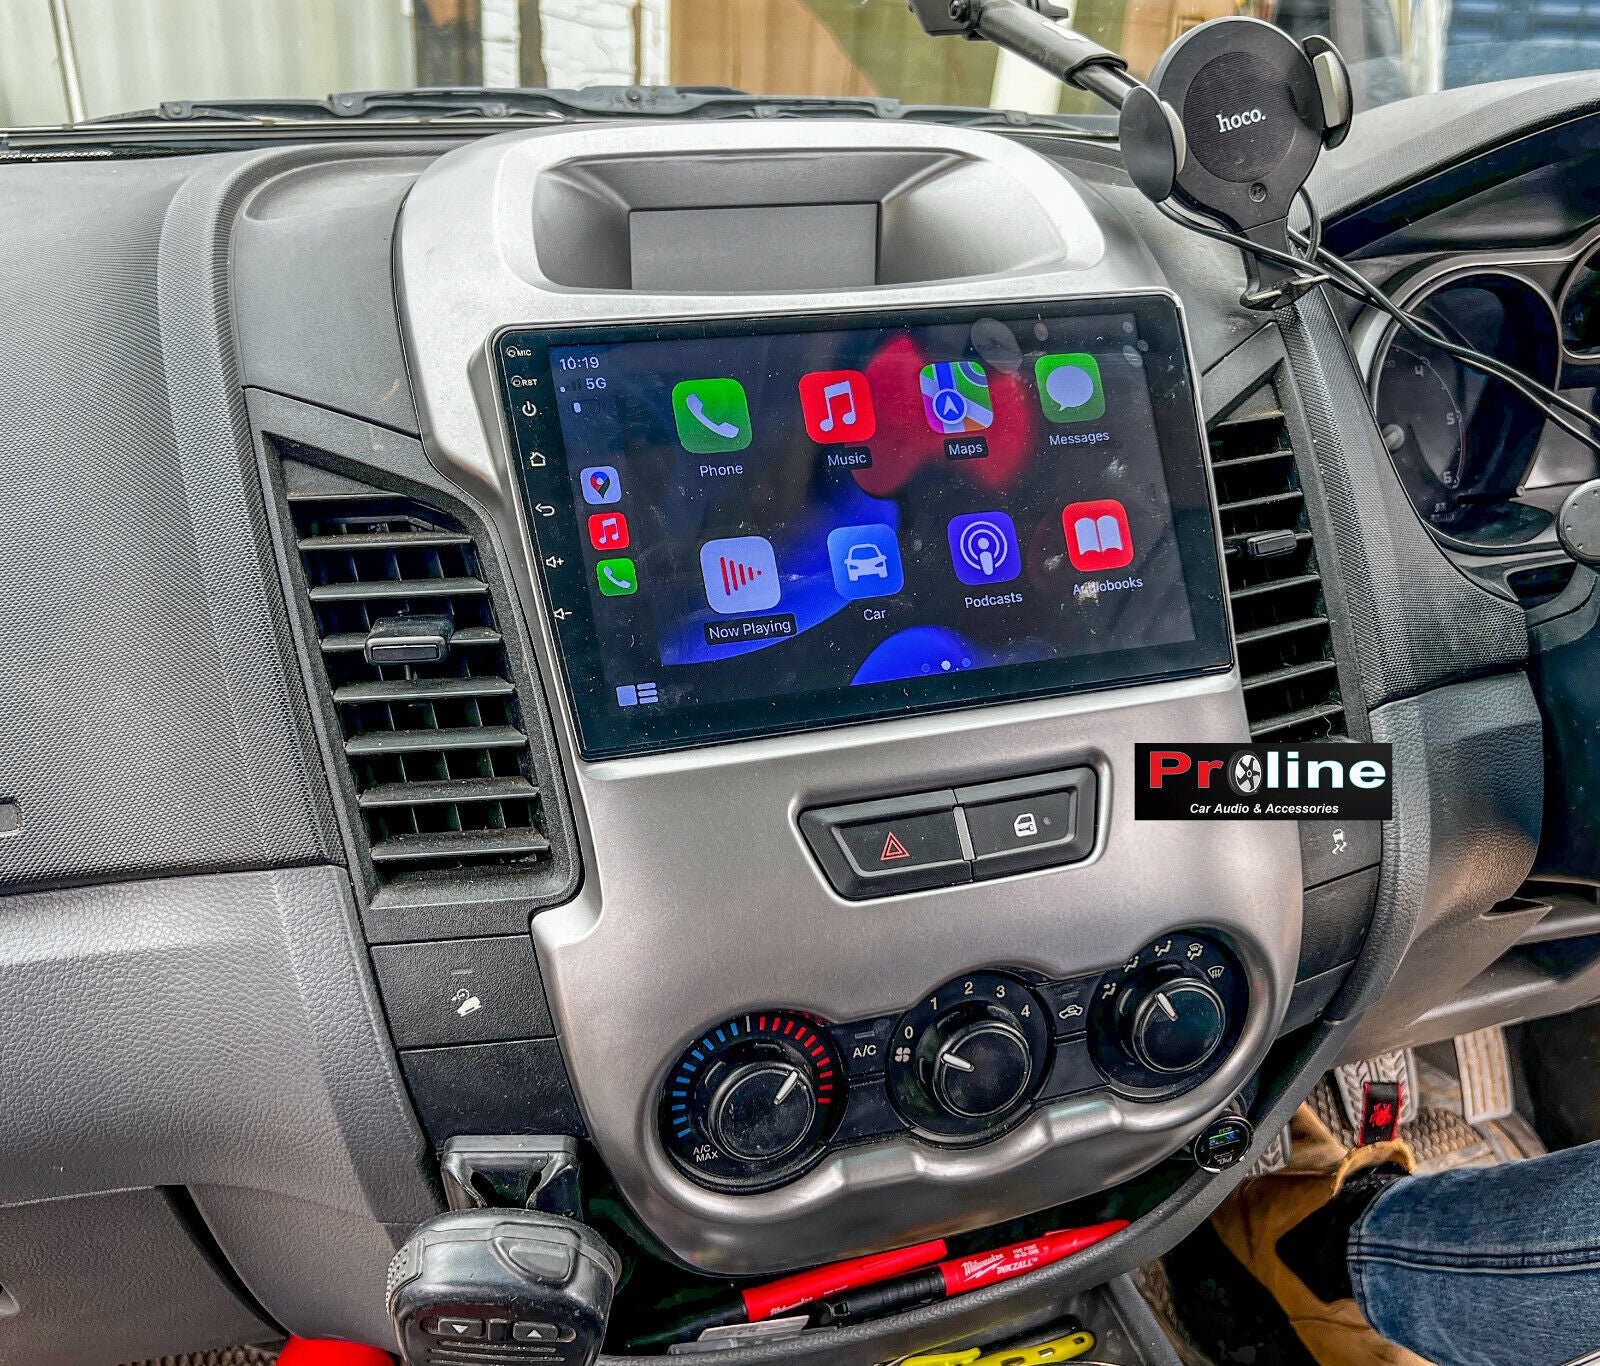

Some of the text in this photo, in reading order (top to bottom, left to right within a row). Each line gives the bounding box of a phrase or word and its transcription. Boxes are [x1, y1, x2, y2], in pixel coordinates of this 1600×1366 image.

[1216, 108, 1267, 133] hoco.
[516, 348, 532, 357] MIC
[560, 357, 600, 371] 10:19
[522, 378, 538, 387] RST
[586, 377, 607, 390] 5G
[1049, 430, 1110, 446] Messages
[948, 442, 983, 457] Maps
[828, 452, 867, 467] Music
[699, 462, 744, 478] Phone
[964, 591, 1023, 609] Podcasts
[863, 608, 886, 621] Car
[709, 618, 792, 640] Now Playing
[965, 981, 974, 995] 2
[996, 985, 1006, 998] 3
[930, 997, 938, 1010] 1
[1021, 1004, 1031, 1017] 4
[904, 1025, 914, 1039] 0
[852, 1044, 877, 1058] A/C
[693, 1144, 711, 1156] A/C
[696, 1150, 719, 1162] MAX
